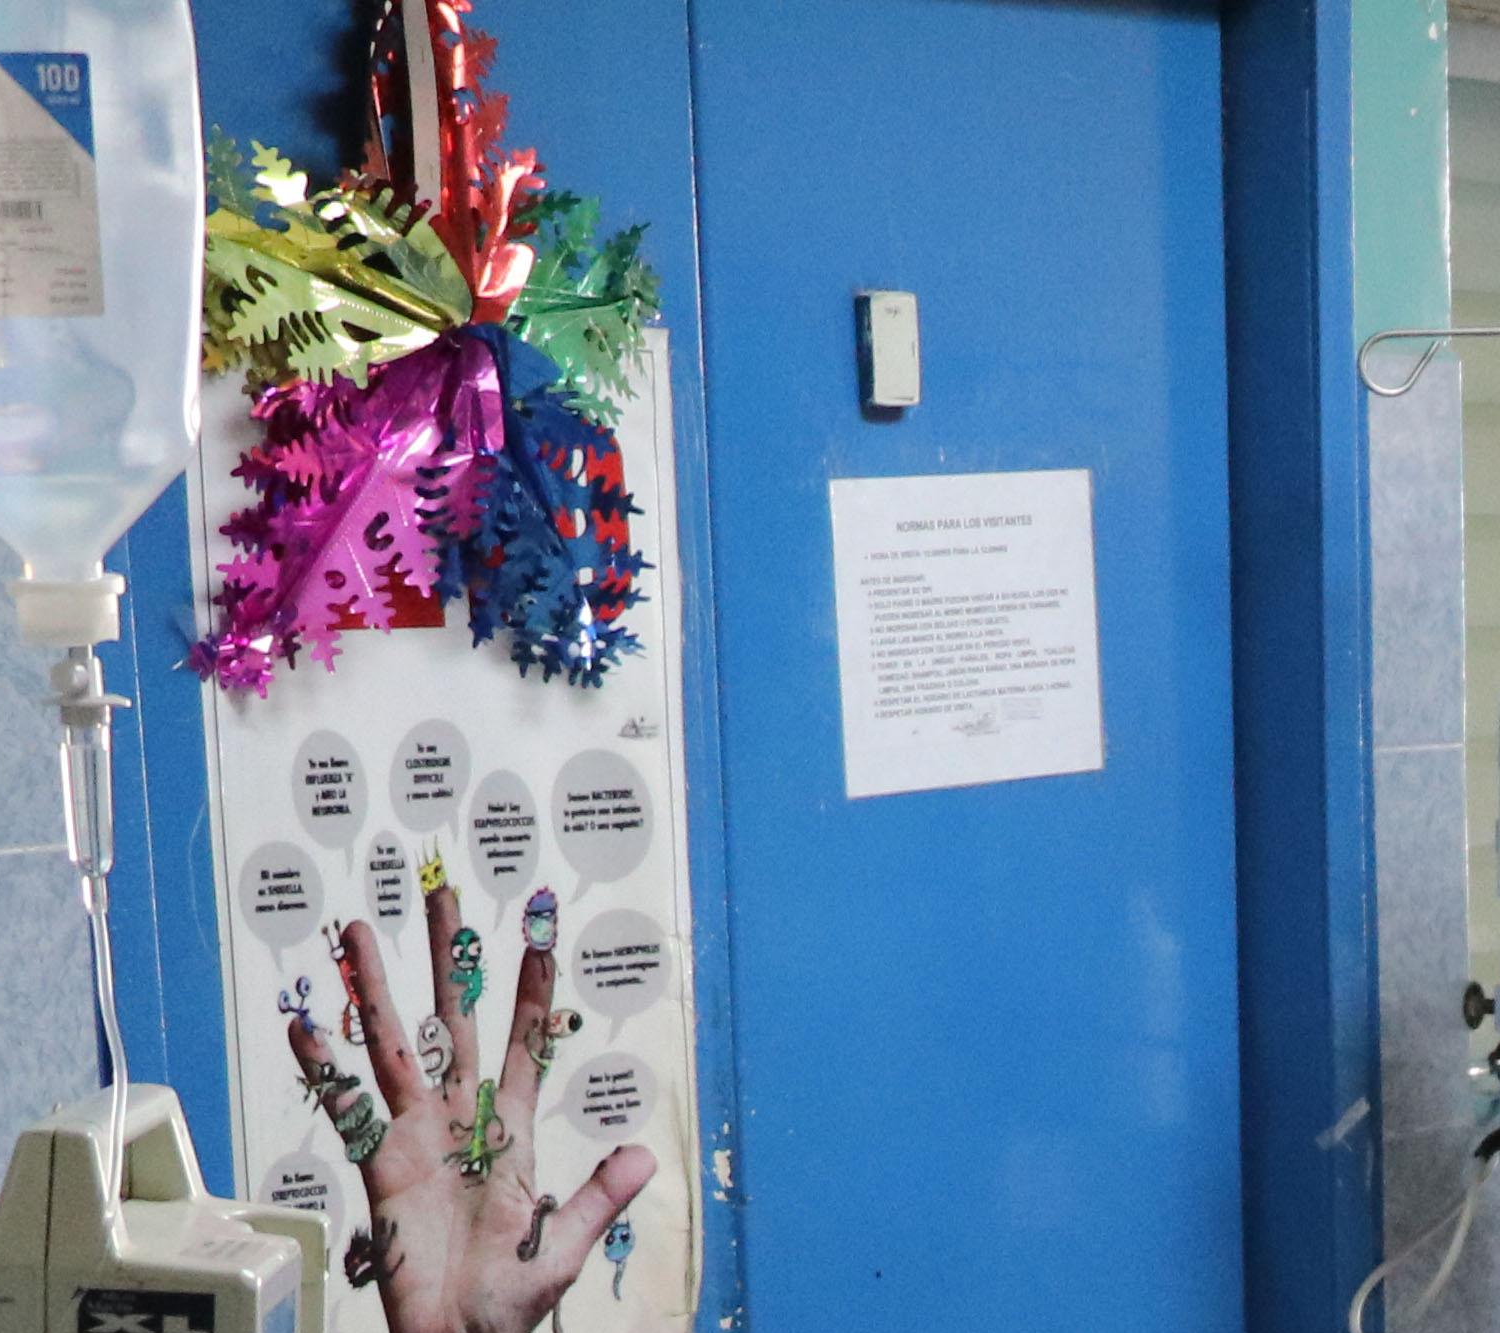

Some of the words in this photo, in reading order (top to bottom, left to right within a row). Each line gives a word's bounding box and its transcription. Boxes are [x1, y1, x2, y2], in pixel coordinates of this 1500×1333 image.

[896, 519, 935, 533] NORMAS
[937, 518, 961, 531] PARA
[963, 517, 981, 529] LOS
[983, 514, 1032, 528] VISITANTES
